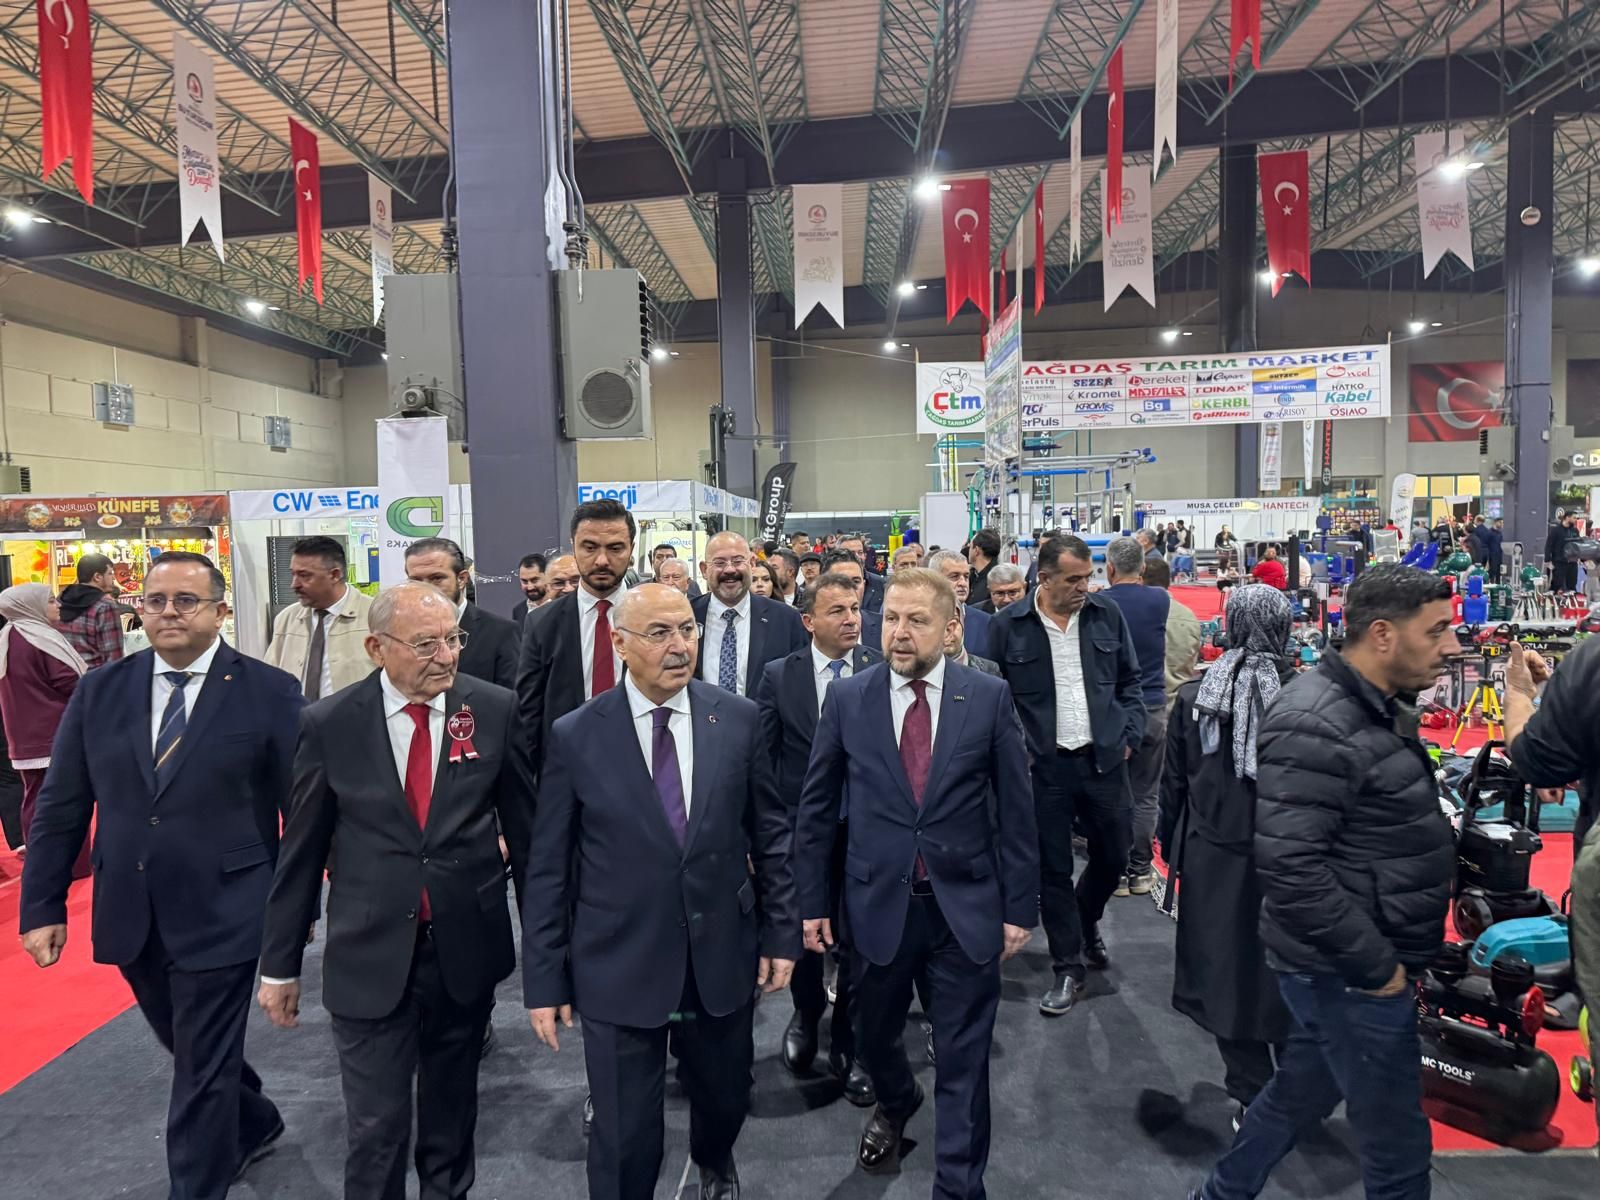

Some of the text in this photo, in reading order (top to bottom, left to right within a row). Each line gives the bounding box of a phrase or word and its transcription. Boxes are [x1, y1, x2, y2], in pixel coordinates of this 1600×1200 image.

[1024, 350, 1380, 377] AĞDAŞ TARIM MARKET
[1078, 390, 1121, 399] Kromel
[1325, 390, 1372, 403] Kabel
[933, 392, 982, 415] Çtm
[1022, 403, 1044, 416] nci
[1145, 401, 1163, 412] Bg
[1202, 397, 1250, 409] KERBL
[272, 491, 313, 513] CW
[577, 486, 637, 510] Enerji
[97, 498, 160, 514] KÜNEFE
[1263, 501, 1309, 510] HANTECH
[1437, 1060, 1472, 1081] TOOLS
